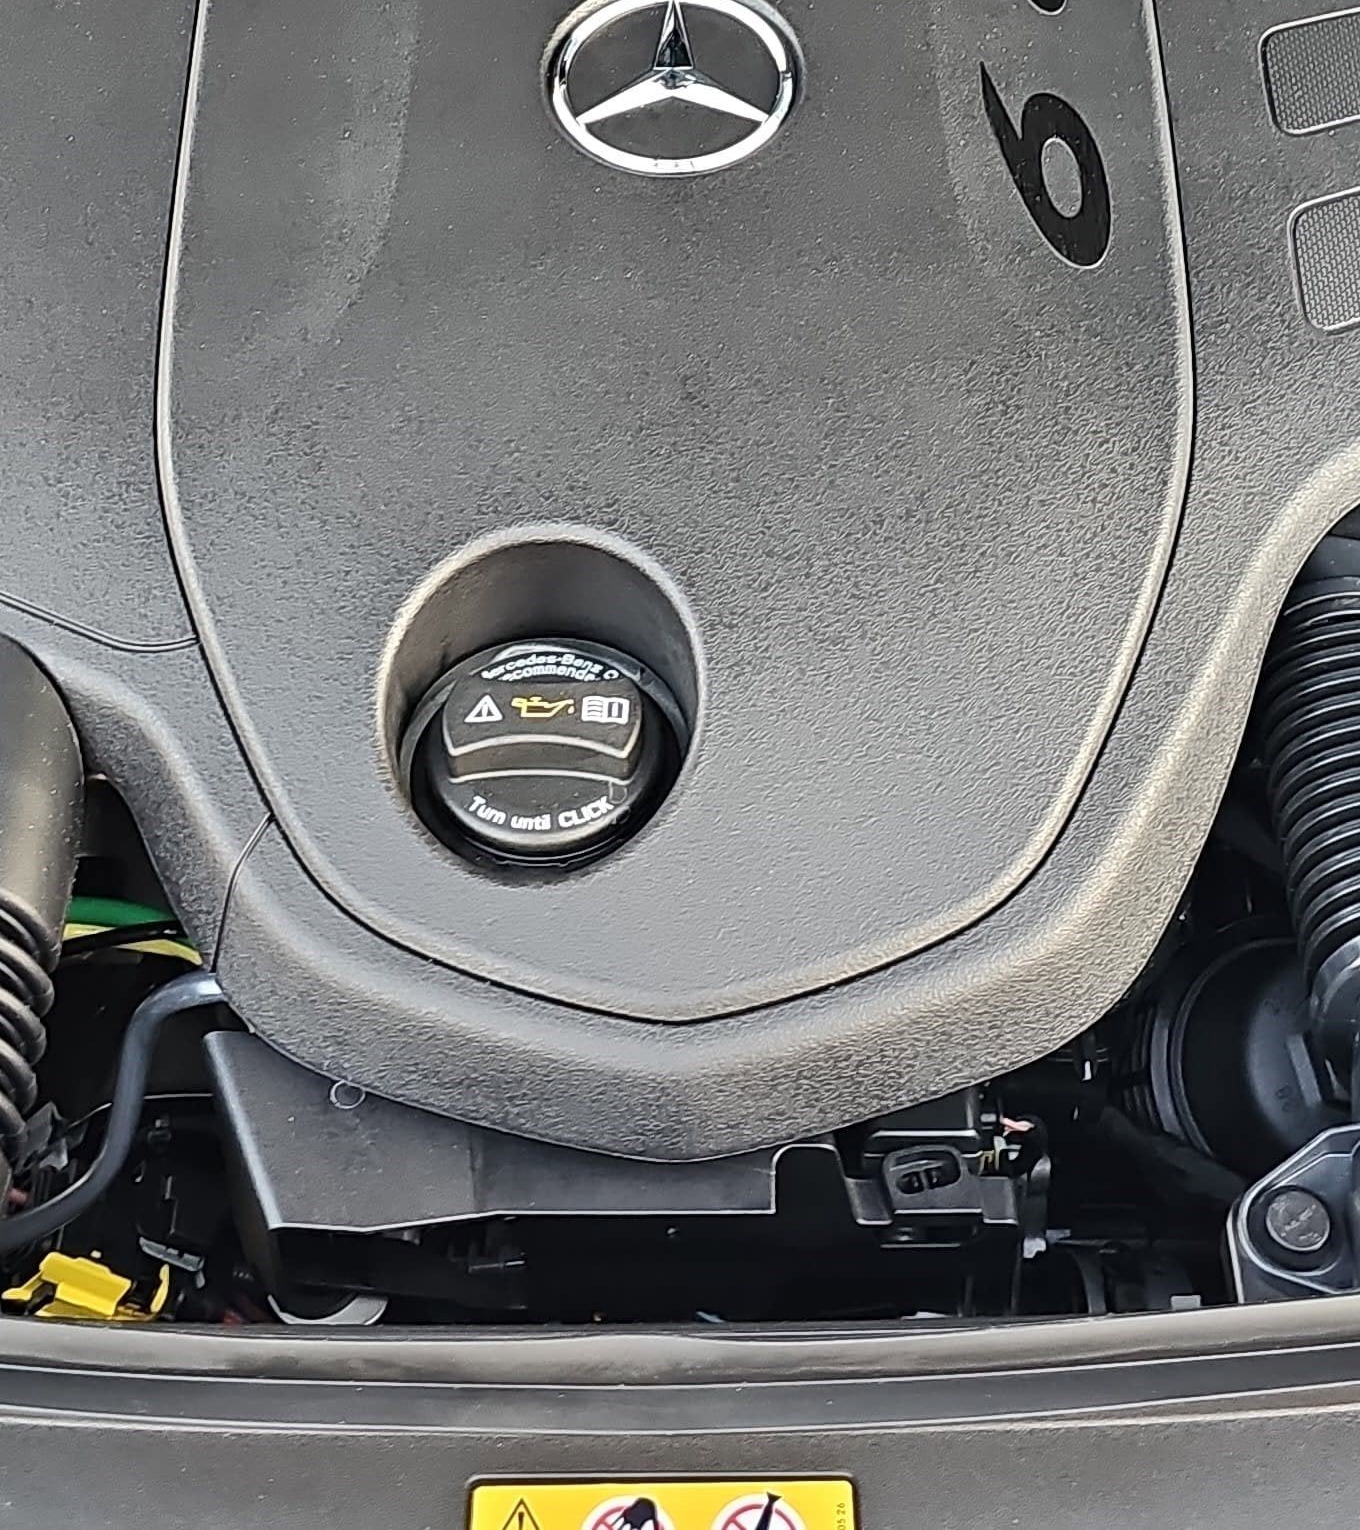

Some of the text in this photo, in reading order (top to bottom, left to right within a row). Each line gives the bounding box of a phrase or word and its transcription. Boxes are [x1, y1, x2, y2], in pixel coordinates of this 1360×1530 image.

[979, 60, 1113, 270] 6
[467, 794, 616, 831] Turn until CLICK
